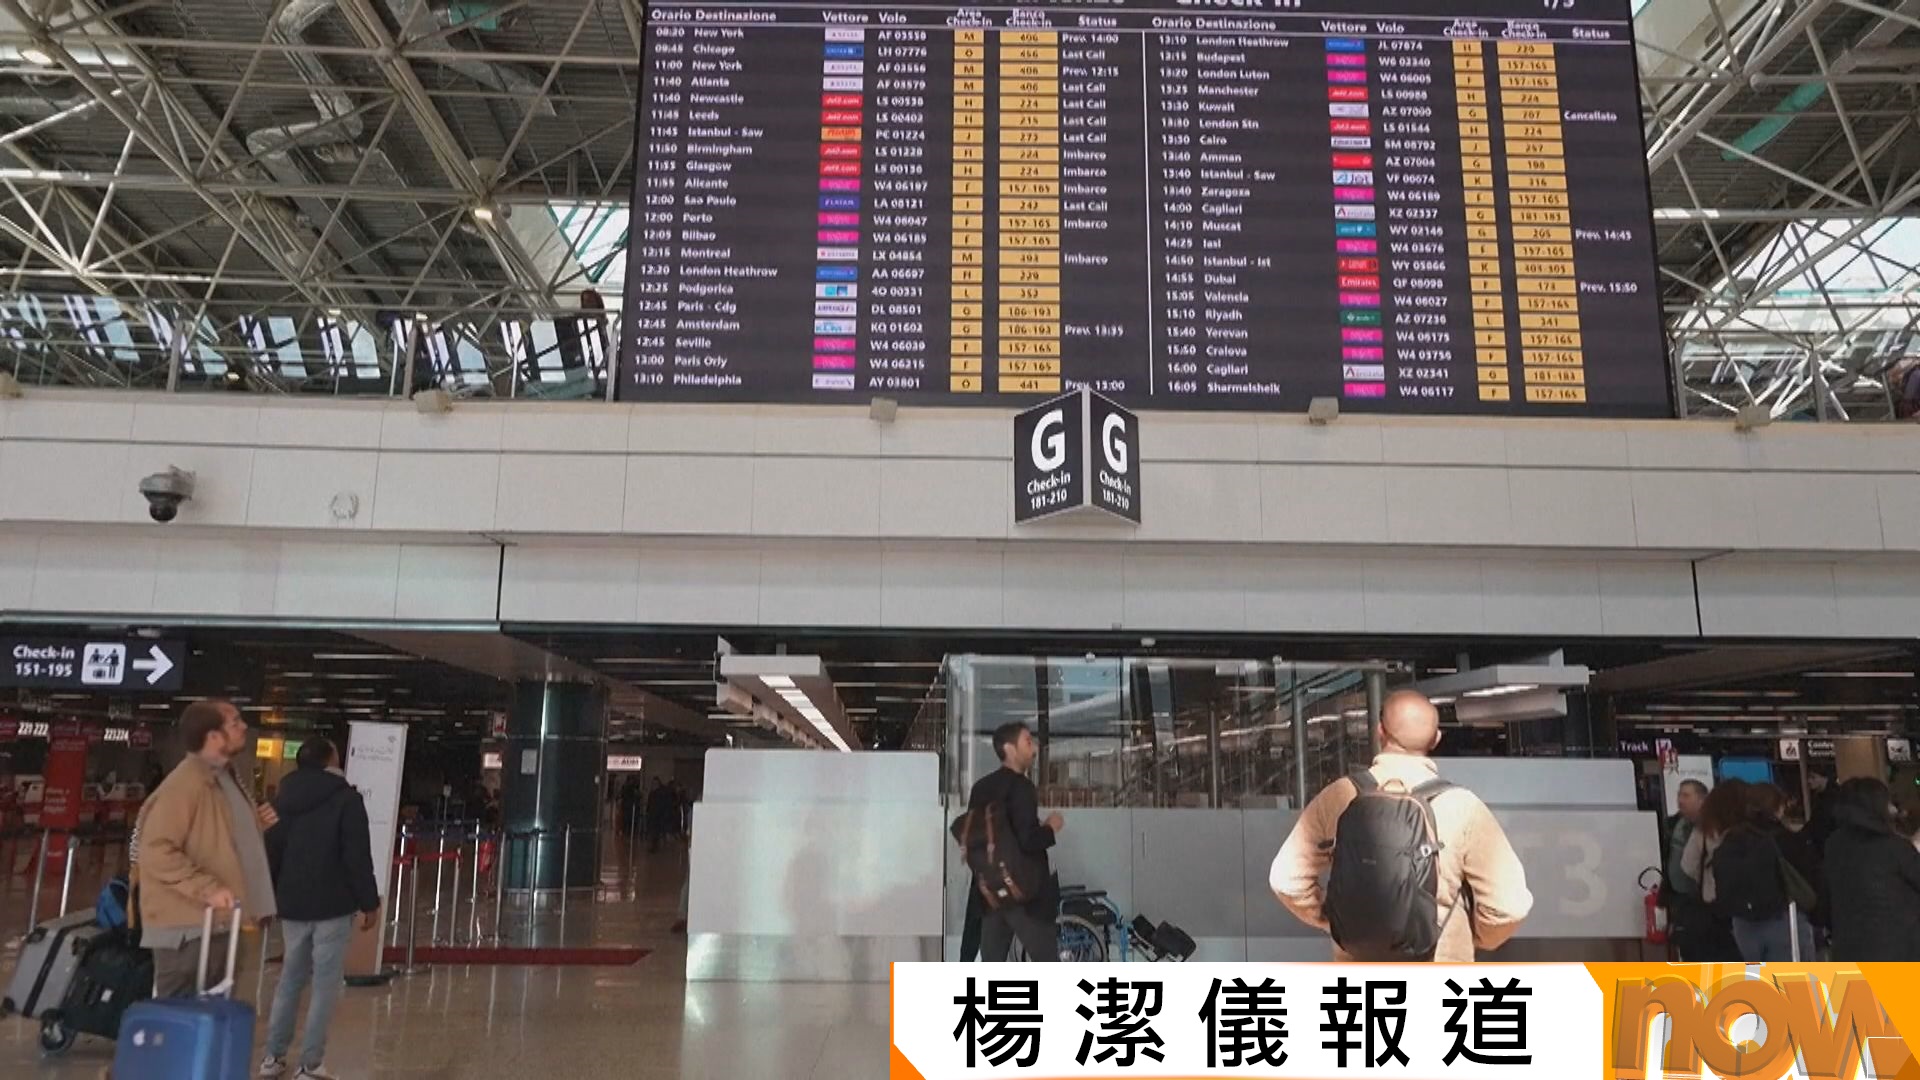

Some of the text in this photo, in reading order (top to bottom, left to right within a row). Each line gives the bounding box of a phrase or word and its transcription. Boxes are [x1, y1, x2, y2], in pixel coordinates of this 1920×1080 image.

[652, 9, 1117, 27] Orario Destinazione Vettore Volo Status
[1152, 17, 1610, 39] Orario Destinazione Vettore Volo Status
[694, 28, 718, 38] New
[721, 28, 744, 38] York
[1090, 34, 1119, 43] 14:00
[1196, 36, 1235, 46] London
[1238, 38, 1289, 47] Heathrow
[693, 44, 1105, 59] Chicago Last Call
[1197, 53, 1245, 64] Budapest
[655, 60, 683, 69] 11:00
[692, 61, 716, 70] New
[720, 61, 742, 71] York
[1198, 69, 1237, 78] London
[1240, 70, 1270, 80] Luton
[654, 77, 1106, 92] 11:40 Atlanta Last Call
[1198, 85, 1258, 96] Manchester
[653, 93, 1106, 109] 11:40 Newcastle Last Call
[690, 111, 1106, 126] Leeds Last Call
[1198, 102, 1235, 112] Kuwait
[1564, 110, 1617, 121] Cancellato
[1199, 118, 1259, 129] London Stn
[688, 127, 731, 136] Istanbul
[742, 128, 763, 137] Saw
[892, 130, 925, 140] 01224
[1064, 133, 1084, 142] Last
[1087, 133, 1107, 143] Call
[1200, 135, 1227, 145] Cairo
[687, 144, 752, 156] Birmingham
[1064, 150, 1106, 160] Imbarco
[1200, 152, 1242, 162] Amman
[686, 161, 1107, 177] Glasgow Imbarco
[1201, 169, 1243, 180] Istanbul
[1254, 170, 1276, 181] Saw
[684, 178, 728, 188] Alicante
[1064, 185, 1107, 194] Imbarco
[1201, 187, 1250, 199] Zaragoza
[646, 195, 674, 205] 12:00
[684, 196, 703, 205] Sao
[707, 196, 736, 206] Paulo
[874, 199, 888, 208] LA
[1064, 201, 1085, 210] Last
[1088, 202, 1108, 212] Call
[1164, 203, 1242, 217] 14:00 Cagliari
[644, 213, 1108, 229] 12:00 Porto Imbarco
[1164, 220, 1192, 230] 14:10
[1202, 221, 1241, 231] Muscat
[1390, 226, 1408, 235] WY
[644, 230, 716, 241] 12:05 Bilbao
[1203, 238, 1222, 248] Iasi
[681, 248, 730, 258] Montreal
[1064, 254, 1108, 264] Imbarco
[1204, 256, 1246, 266] Istanbul
[1258, 257, 1271, 267] Ist
[1392, 260, 1410, 270] WY
[680, 266, 721, 276] London
[724, 267, 778, 277] Heathrow
[679, 283, 734, 296] Podgorica
[1204, 274, 1236, 284] Dubai
[1580, 282, 1606, 292] Prev.
[1204, 292, 1249, 303] Valencia
[638, 301, 667, 311] 12:45
[678, 302, 703, 312] Paris
[714, 302, 737, 314] Cdg
[871, 304, 885, 314] DL
[1206, 309, 1242, 322] Riyadh
[1395, 314, 1410, 324] AZ
[638, 319, 740, 330] 12:45 Amsterdam
[1206, 328, 1248, 339] Yerevan
[637, 337, 711, 348] 12:45 Seville
[1206, 346, 1247, 357] Craiova
[635, 356, 727, 368] 13:00 Paris Orly
[1168, 363, 1197, 373] 16:00
[1207, 364, 1248, 377] Cagliari
[674, 374, 742, 387] Philadelphia
[869, 377, 883, 387] AY
[1168, 382, 1197, 391] 16:05
[1208, 382, 1280, 393] Sharmelsheik
[1400, 387, 1418, 397] W4
[1031, 409, 1066, 472] G
[1102, 412, 1128, 474] G
[1027, 470, 1071, 495] Check-in
[1100, 470, 1132, 496] Check-in
[1030, 489, 1067, 510] 181-210
[1102, 489, 1129, 511] 181-210
[12, 644, 75, 660] Check-in
[15, 663, 72, 677] 151-195
[1620, 741, 1648, 752] Track
